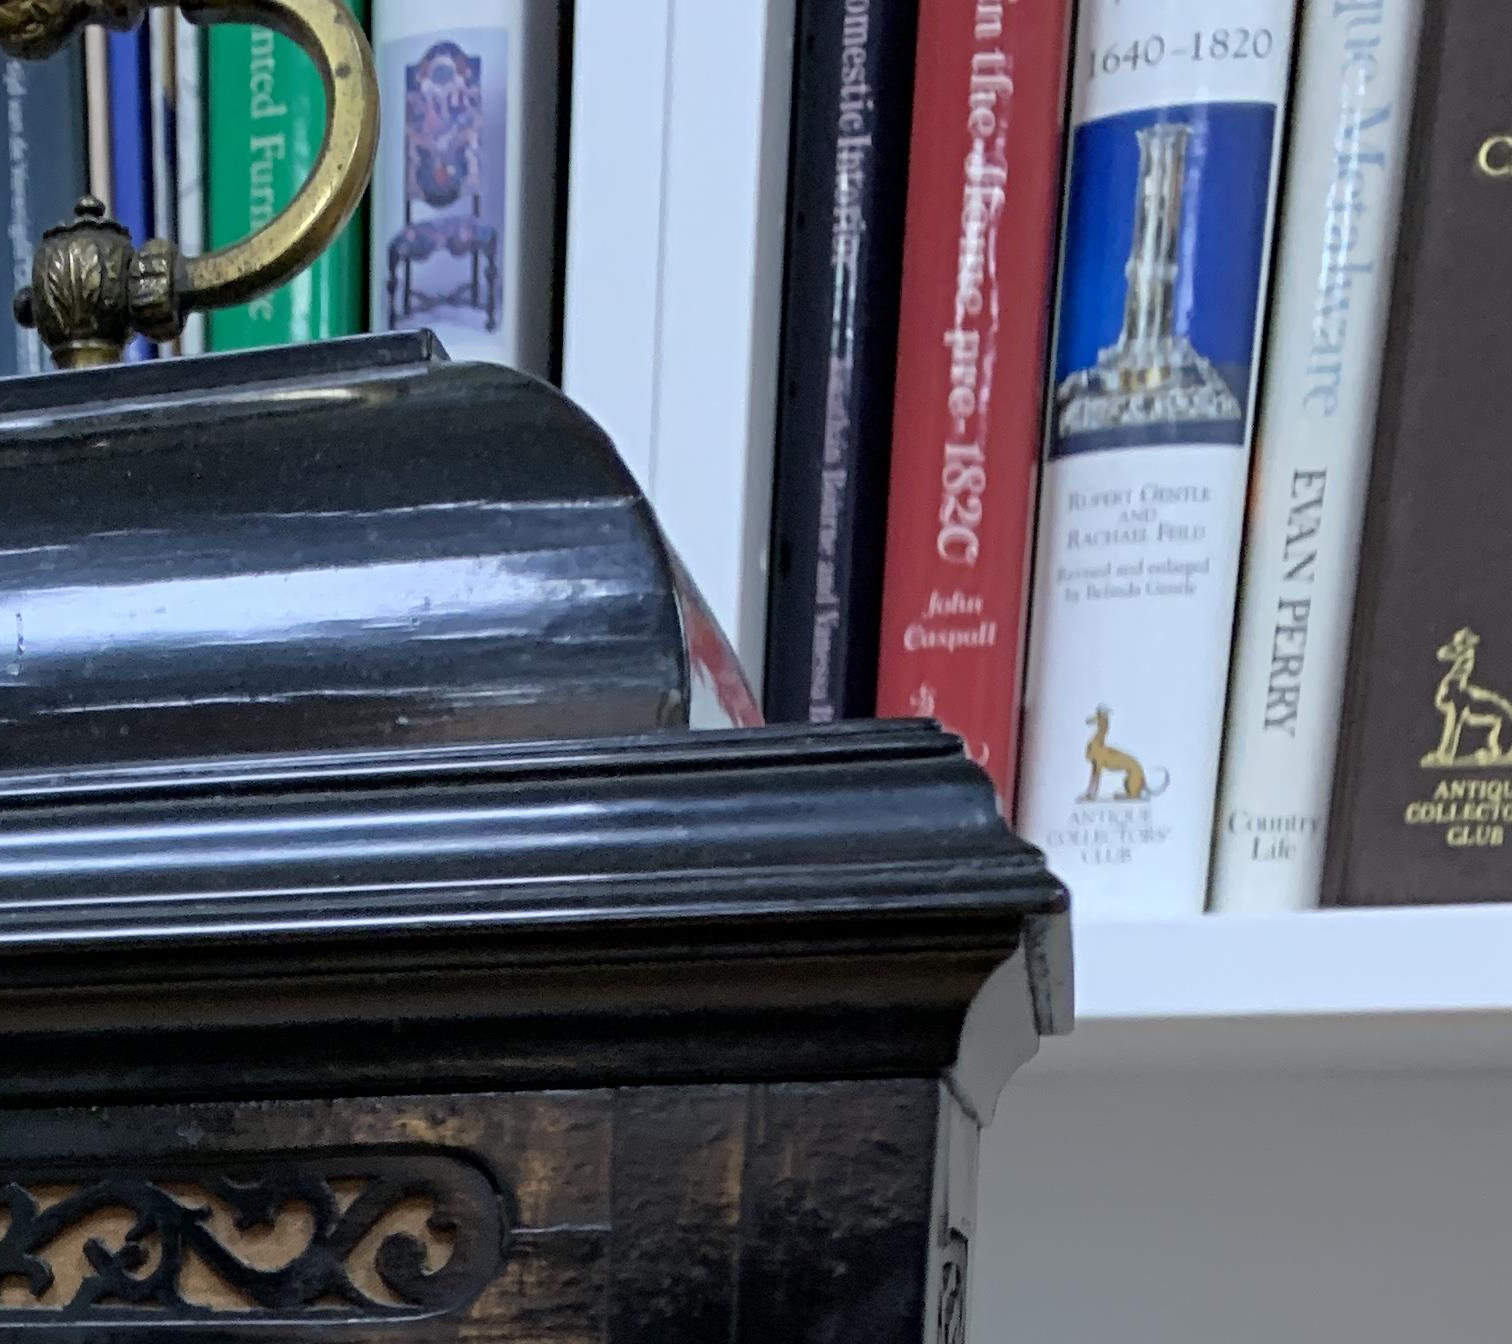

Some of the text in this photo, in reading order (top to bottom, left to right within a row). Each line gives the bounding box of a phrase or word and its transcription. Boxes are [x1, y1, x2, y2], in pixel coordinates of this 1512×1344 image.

[249, 27, 286, 120] nted
[968, 48, 1014, 137] the
[921, 589, 984, 619] John
[1264, 468, 1328, 737] EVAN PERRY
[1447, 825, 1504, 846] CLUB
